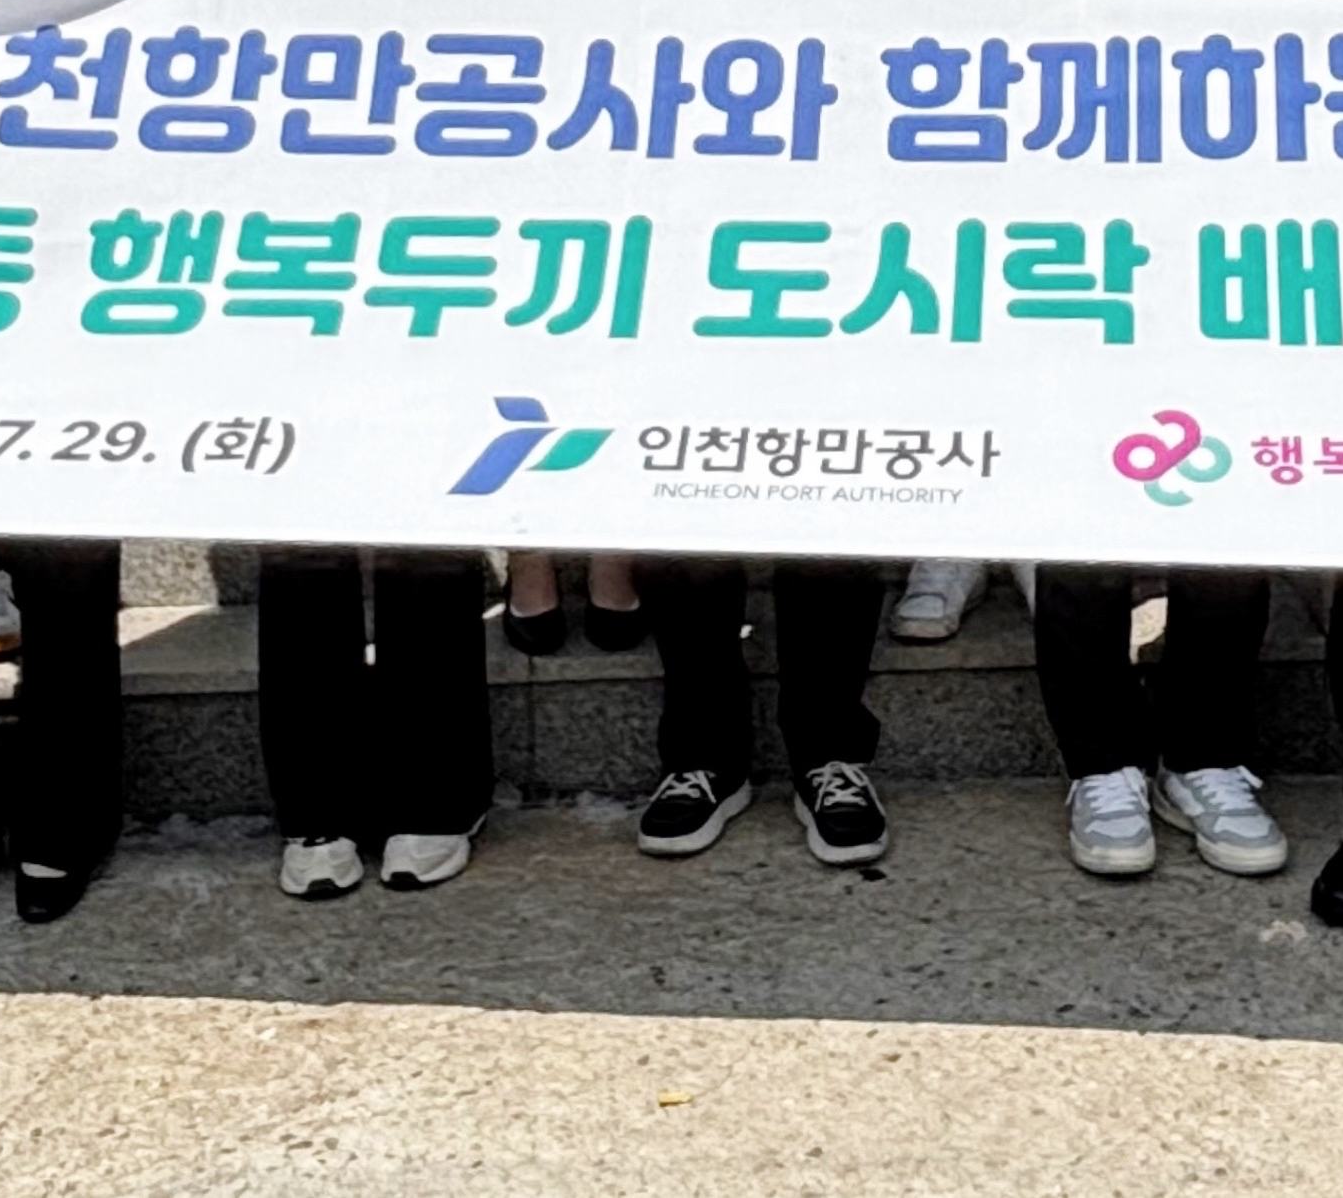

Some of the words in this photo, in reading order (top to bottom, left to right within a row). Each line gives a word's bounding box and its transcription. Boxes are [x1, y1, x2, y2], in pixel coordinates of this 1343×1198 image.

[79, 208, 654, 340] 행복두끼
[692, 218, 1151, 346] 도시락
[51, 420, 157, 463] 29.
[181, 416, 297, 475] (화)
[638, 425, 1002, 480] 인천항만공사
[653, 483, 760, 499] INCHEON
[767, 484, 826, 501] PORT
[832, 486, 963, 504] AUTHORITY
